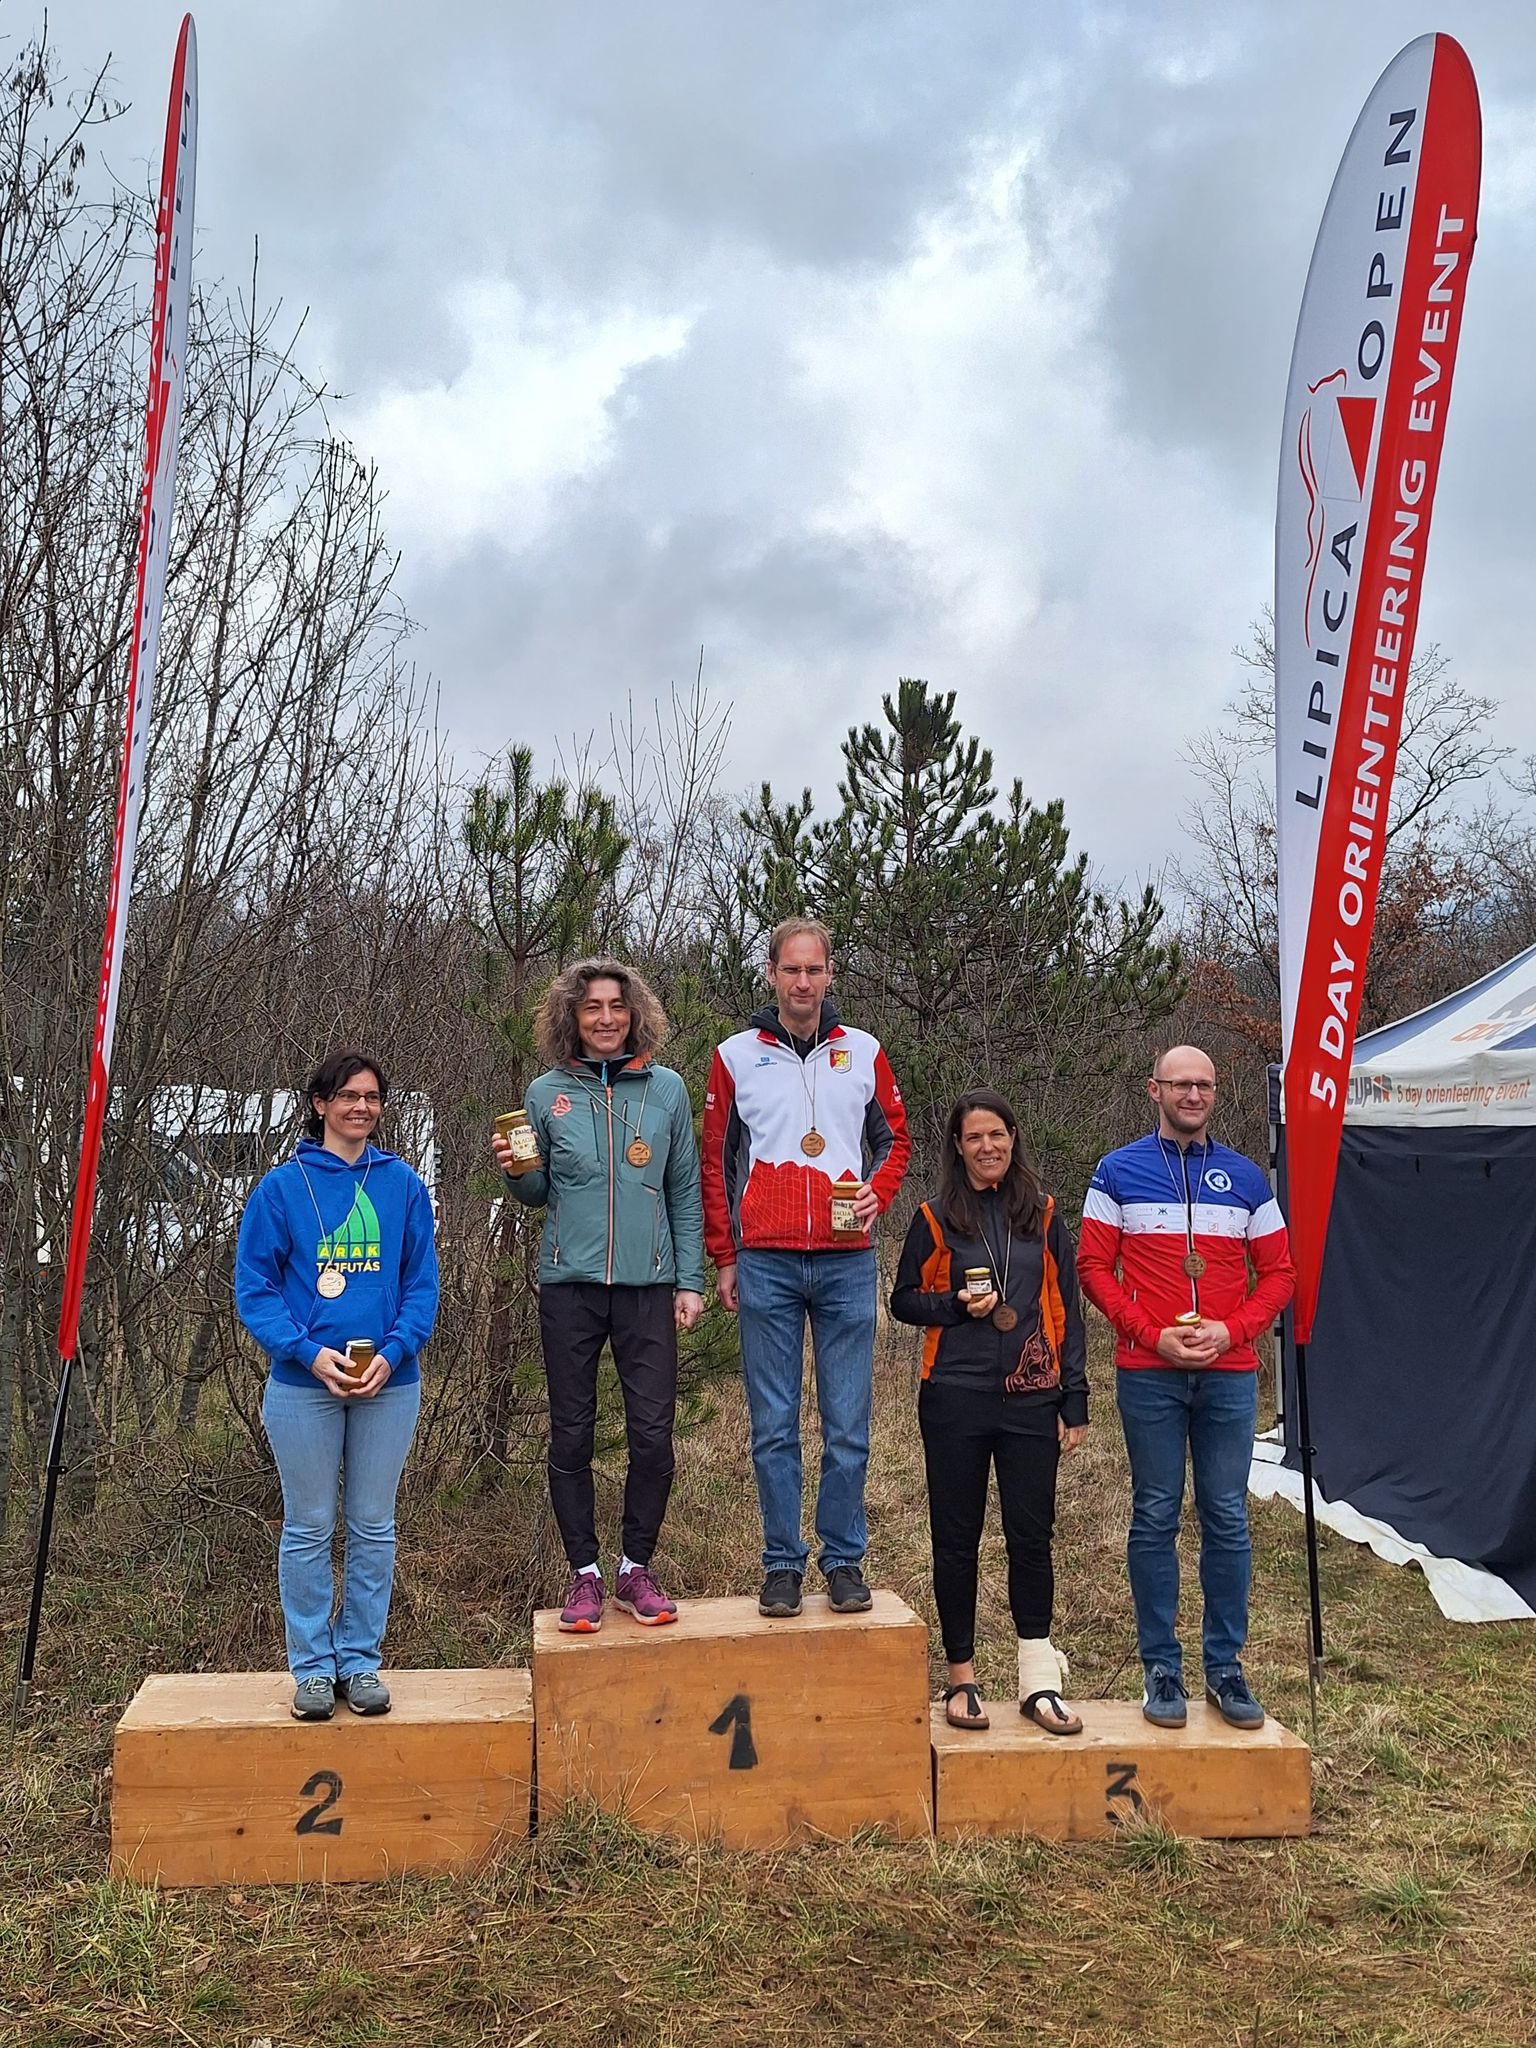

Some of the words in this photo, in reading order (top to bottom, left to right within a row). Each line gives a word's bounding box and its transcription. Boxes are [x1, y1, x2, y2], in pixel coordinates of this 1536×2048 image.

[1408, 203, 1465, 432] EVENT
[1295, 520, 1358, 811] LIPICA
[1358, 107, 1417, 381] OPEN
[1338, 459, 1428, 927] ORIENTEERING
[1319, 938, 1356, 1061] DAY
[1309, 1071, 1338, 1111] 5
[1397, 1084, 1404, 1104] 5
[1405, 1083, 1422, 1108] day
[1426, 1081, 1494, 1107] orienteering
[1496, 1078, 1531, 1100] event
[319, 1246, 378, 1258] ARAK
[708, 1693, 759, 1770] 1
[295, 1770, 344, 1836] 2
[1105, 1763, 1143, 1829] 3
